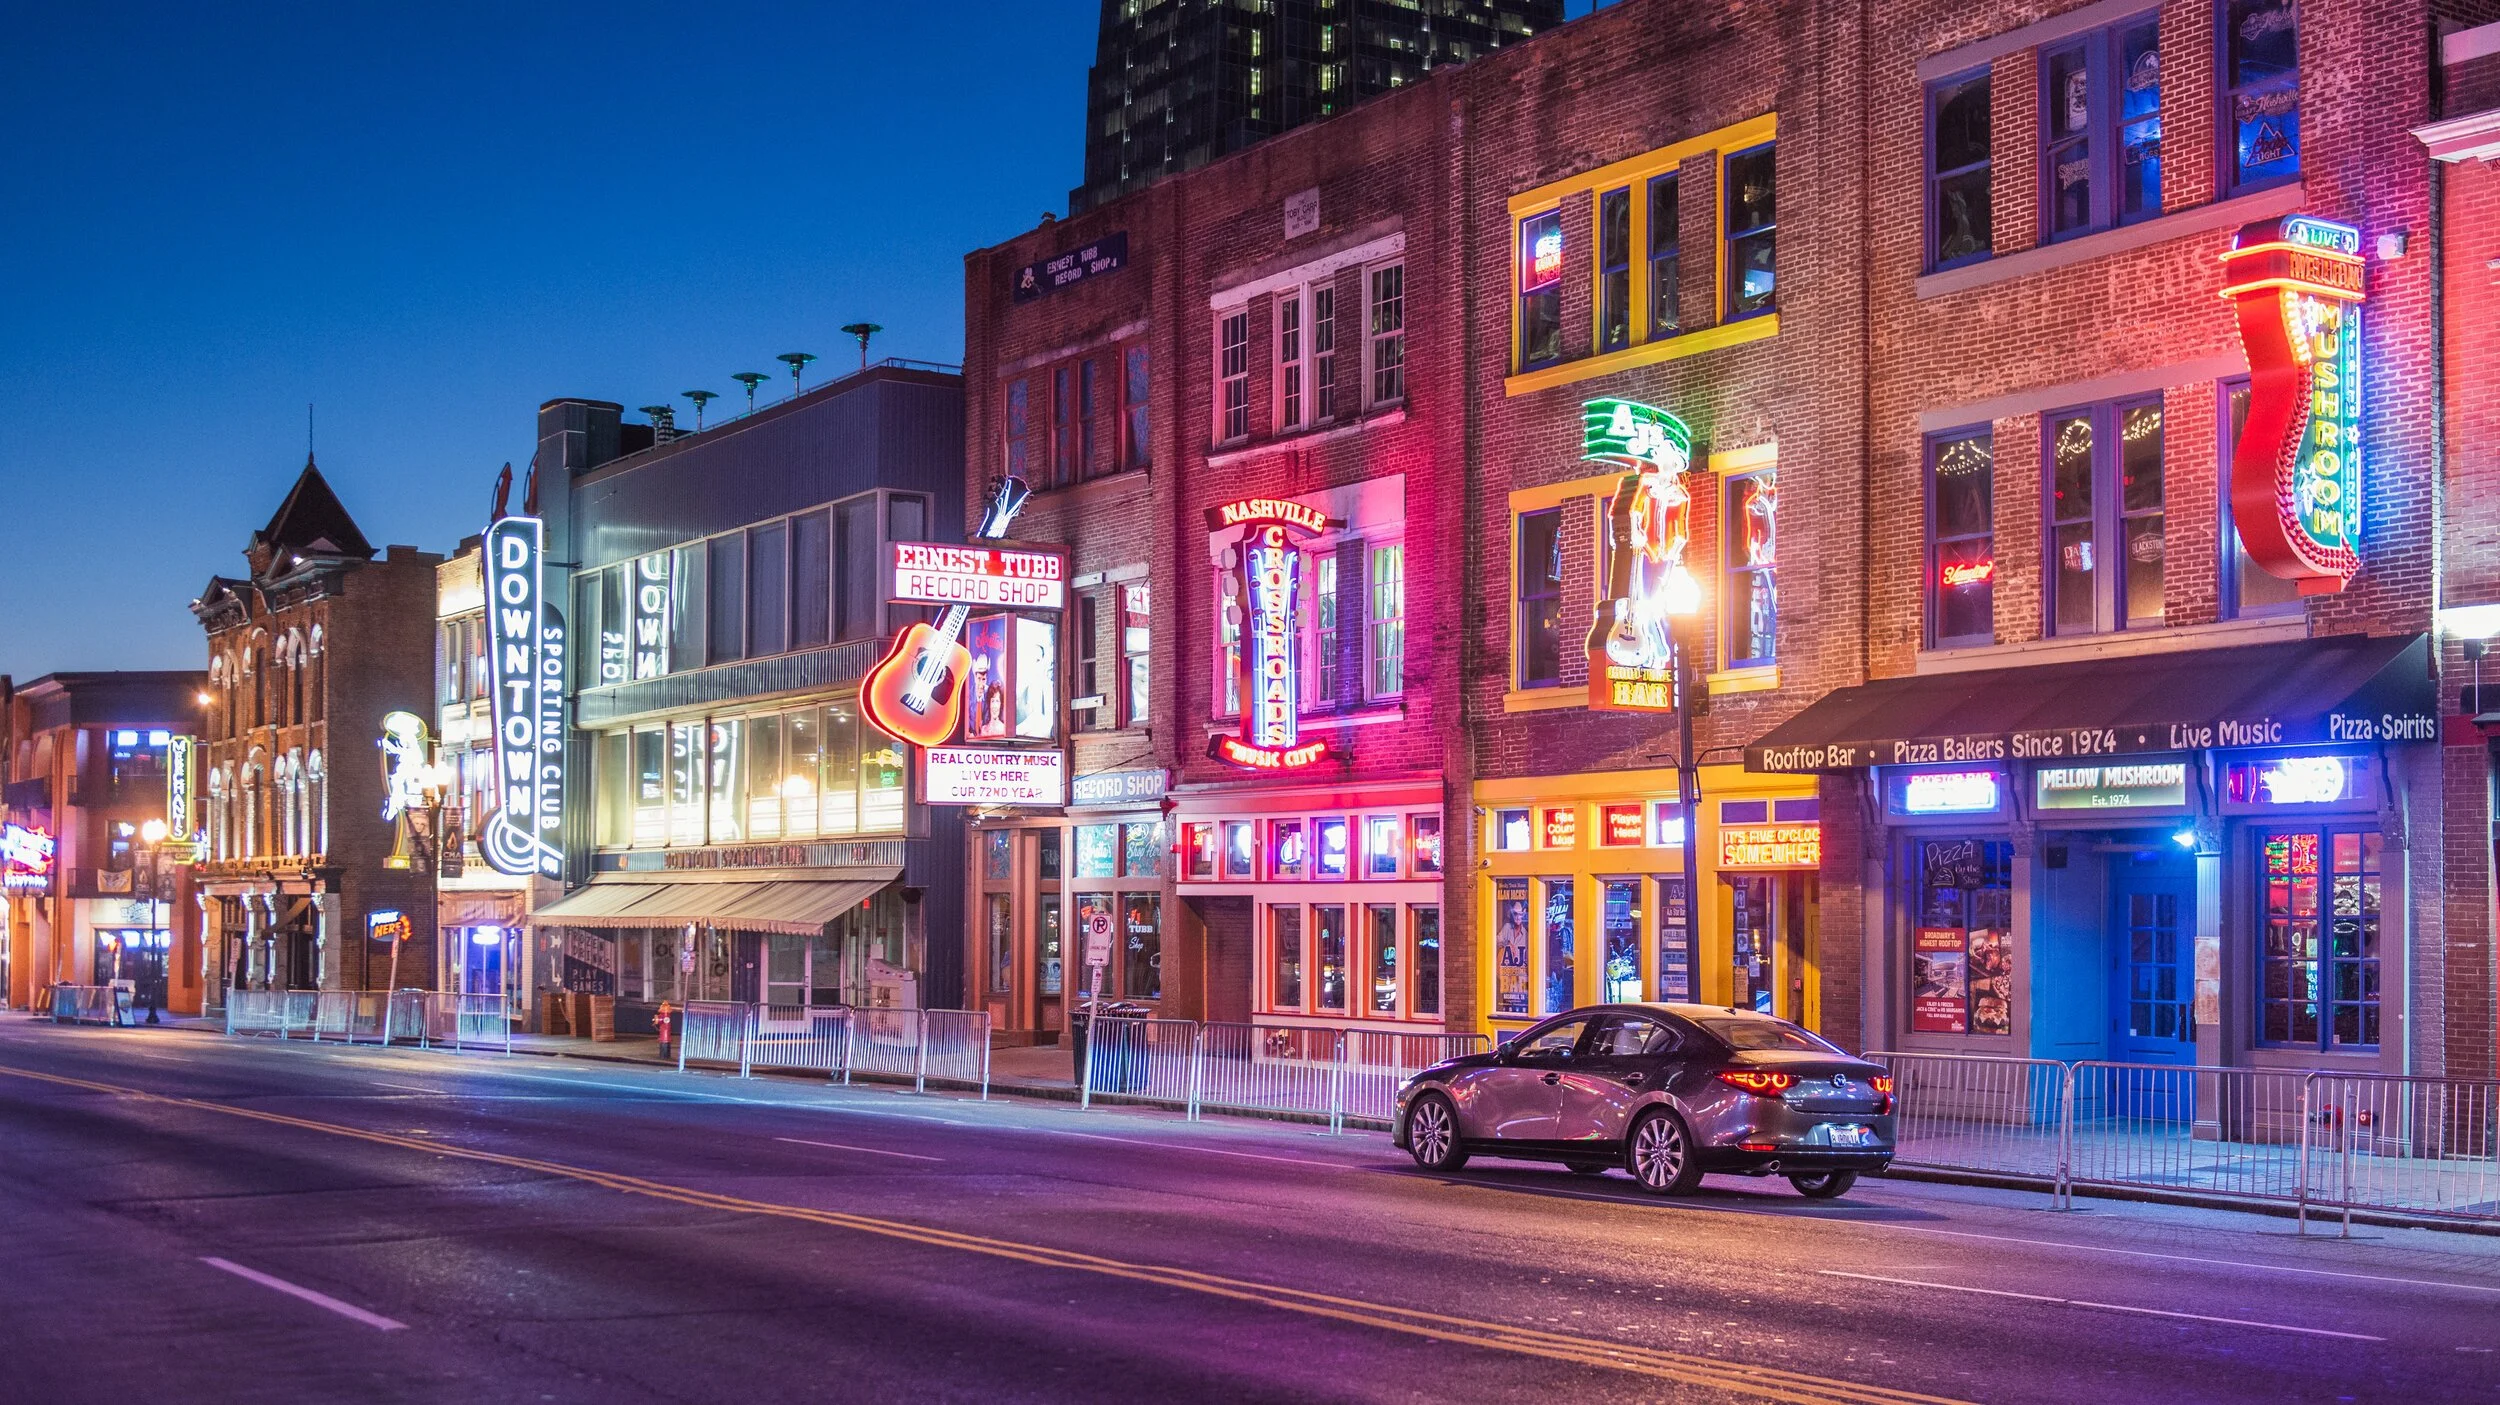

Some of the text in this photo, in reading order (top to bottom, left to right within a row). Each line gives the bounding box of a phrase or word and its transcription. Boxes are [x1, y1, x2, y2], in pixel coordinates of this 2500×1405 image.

[2257, 148, 2281, 161] LIGHT
[2311, 229, 2340, 249] LIVE
[1046, 245, 1098, 274] ERNEST TUBB
[1055, 258, 1111, 286] RECORD SHOP
[2314, 303, 2341, 536] MUSHROOM
[1221, 499, 1327, 533] NASHVILLE
[897, 545, 1060, 579] ERNEST TUBB
[911, 575, 1048, 604] RECORD SHOP
[1263, 526, 1289, 746] CROSSROADS
[501, 535, 533, 816] DOWNTOWN
[543, 627, 563, 753] SPORTING
[1613, 681, 1668, 707] BAR
[2330, 714, 2435, 740] Pizza Spirits
[1763, 718, 2282, 771] Rooftop Bar Pizza Bakers Since 1974 Live Music
[931, 753, 1057, 767] REAL COUNTRY MUSIC
[961, 770, 1030, 782] LIVES HERE
[1073, 775, 1162, 799] RECORD SHOP
[2042, 763, 2185, 790] MELLOW MUSHROOM
[172, 740, 187, 838] MERCHANTS
[541, 770, 562, 830] CLUB
[951, 786, 1043, 799] OUR 72ND YEAR
[2092, 794, 2130, 807] Est. 1974
[1749, 830, 1775, 843] FIVE
[443, 851, 461, 859] CMA
[1127, 841, 1145, 860] Shop
[374, 922, 402, 938] HERE
[1129, 925, 1153, 933] TUBB
[1924, 932, 1956, 940] BROADWAY'S
[1129, 936, 1144, 952] Shop
[1920, 940, 1962, 948] HIGHEST ROOFTOP
[572, 968, 597, 981] PLAY
[572, 980, 605, 992] GAMES
